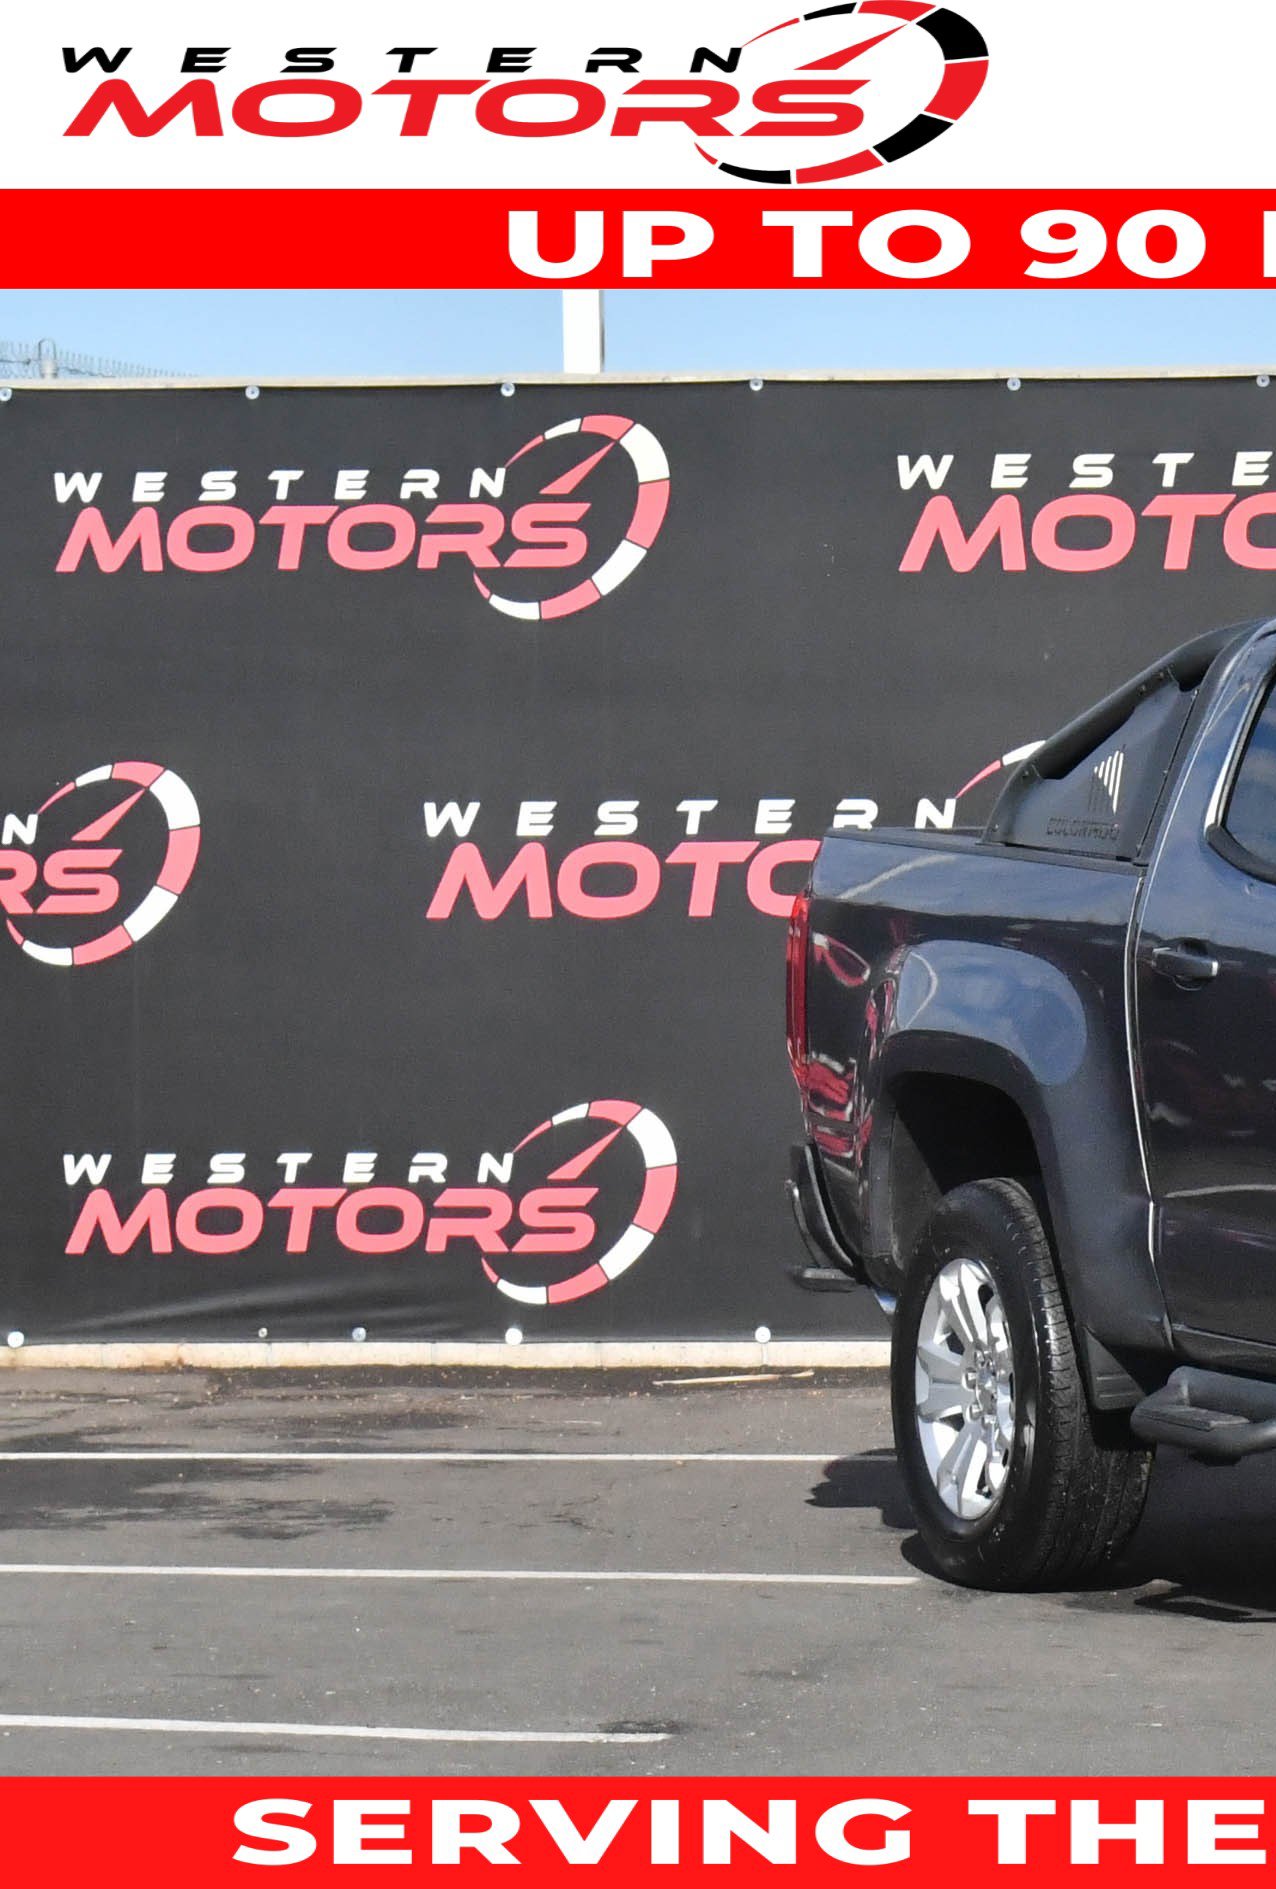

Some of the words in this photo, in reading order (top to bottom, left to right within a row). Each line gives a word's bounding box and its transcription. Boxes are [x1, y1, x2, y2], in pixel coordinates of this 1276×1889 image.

[55, 468, 506, 503] WESTERN
[56, 503, 591, 572] MOTORS
[424, 799, 957, 837] WESTERN
[63, 1152, 514, 1187] WESTERN
[65, 1186, 599, 1255] MOTORS
